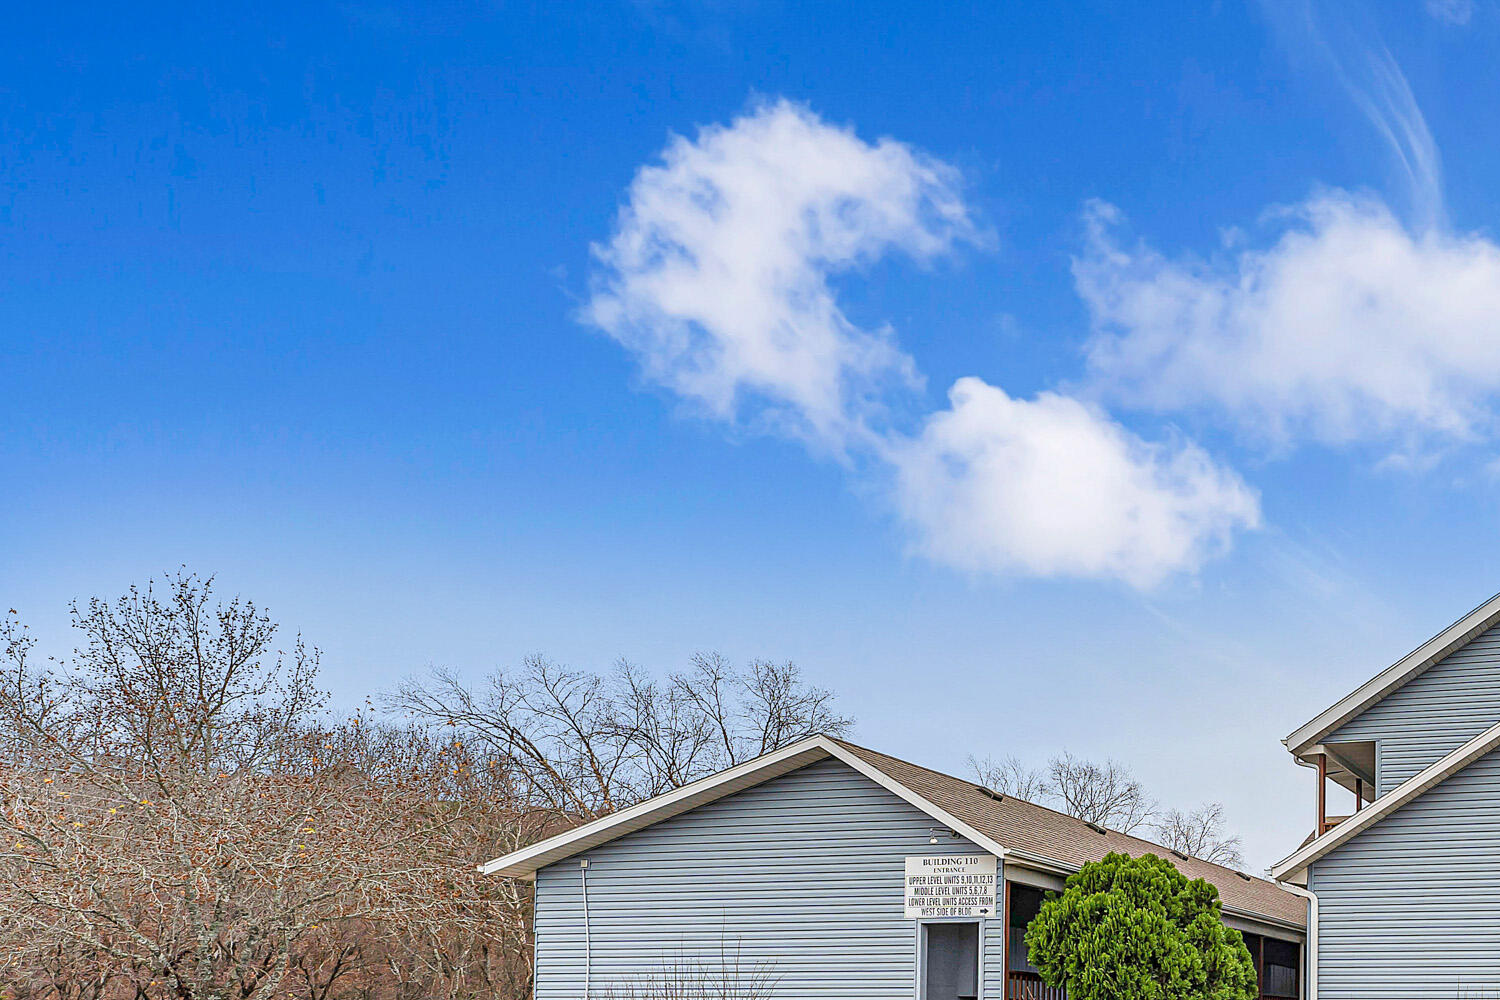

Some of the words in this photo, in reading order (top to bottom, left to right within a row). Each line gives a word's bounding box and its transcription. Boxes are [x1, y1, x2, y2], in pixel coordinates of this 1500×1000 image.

[923, 858, 962, 866] BUILDING
[908, 876, 926, 885] UPPER
[928, 876, 942, 884] LEVEL
[944, 876, 960, 884] UNITS
[914, 887, 934, 896] MIDDLE
[936, 887, 950, 895] LEVEL
[952, 886, 968, 895] UNITS
[908, 898, 925, 906] LOWER
[926, 898, 940, 906] LEVEL
[942, 897, 958, 906] UNITS
[958, 897, 978, 906] ACCESS
[978, 896, 993, 906] FROM
[950, 908, 956, 916] OF
[958, 908, 972, 916] BLDG
